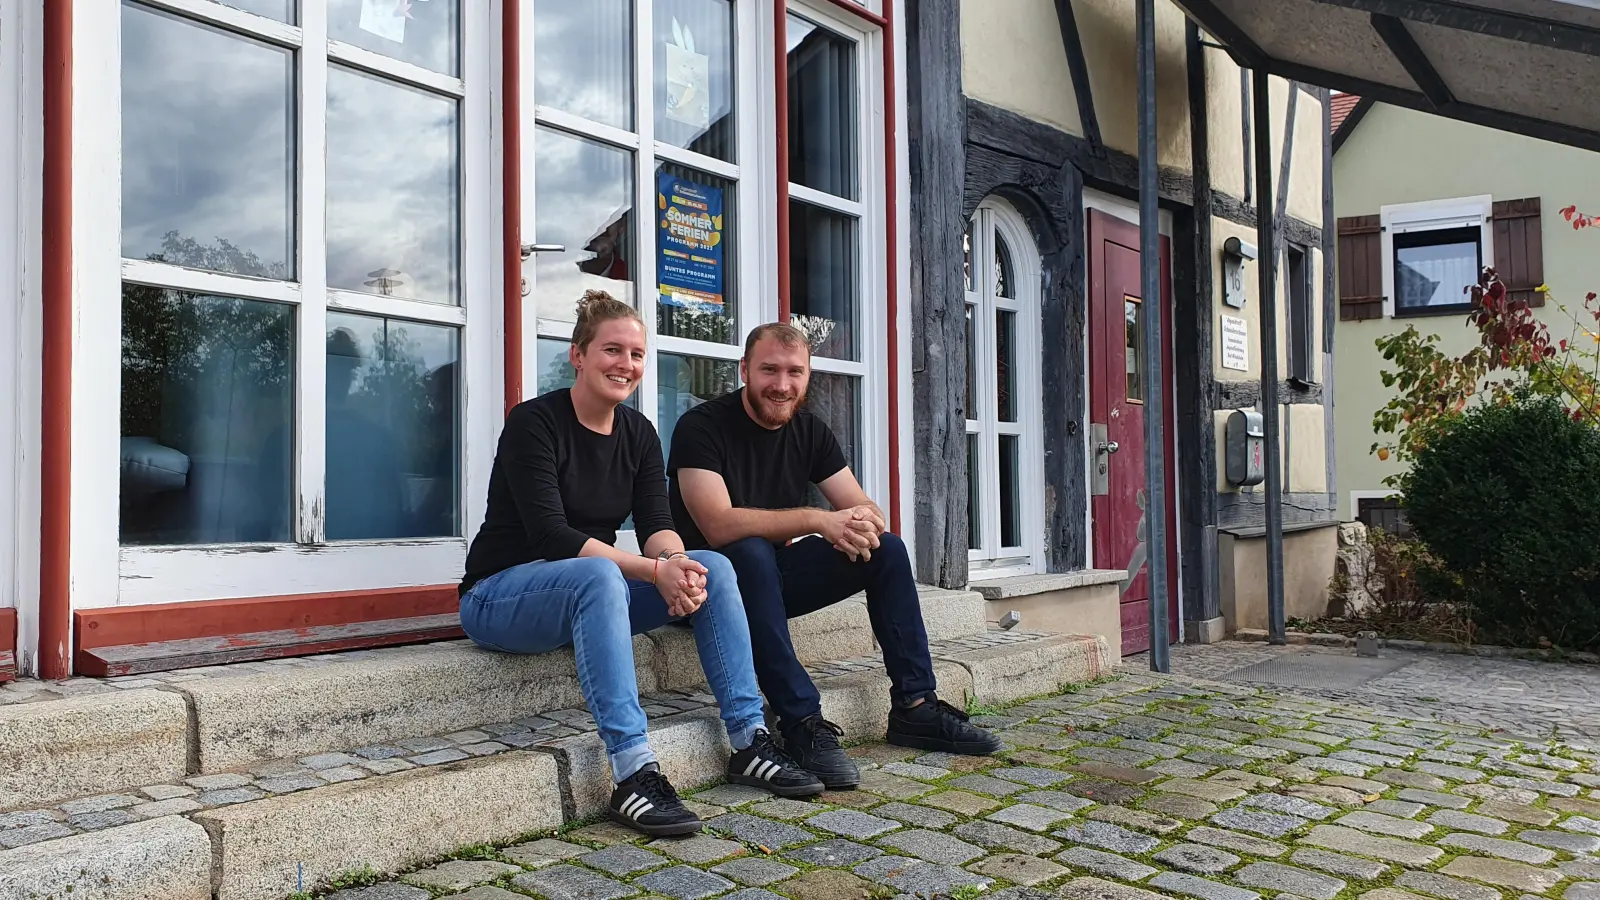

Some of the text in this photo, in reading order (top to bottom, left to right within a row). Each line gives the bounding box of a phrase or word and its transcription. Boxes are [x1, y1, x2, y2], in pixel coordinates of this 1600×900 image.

[667, 209, 712, 230] SOMMER
[670, 222, 709, 241] FERIEN
[666, 236, 698, 248] PROGRAMM
[664, 265, 686, 274] BUNTES
[686, 269, 716, 280] PROGRAMM
[1230, 269, 1241, 292] 16
